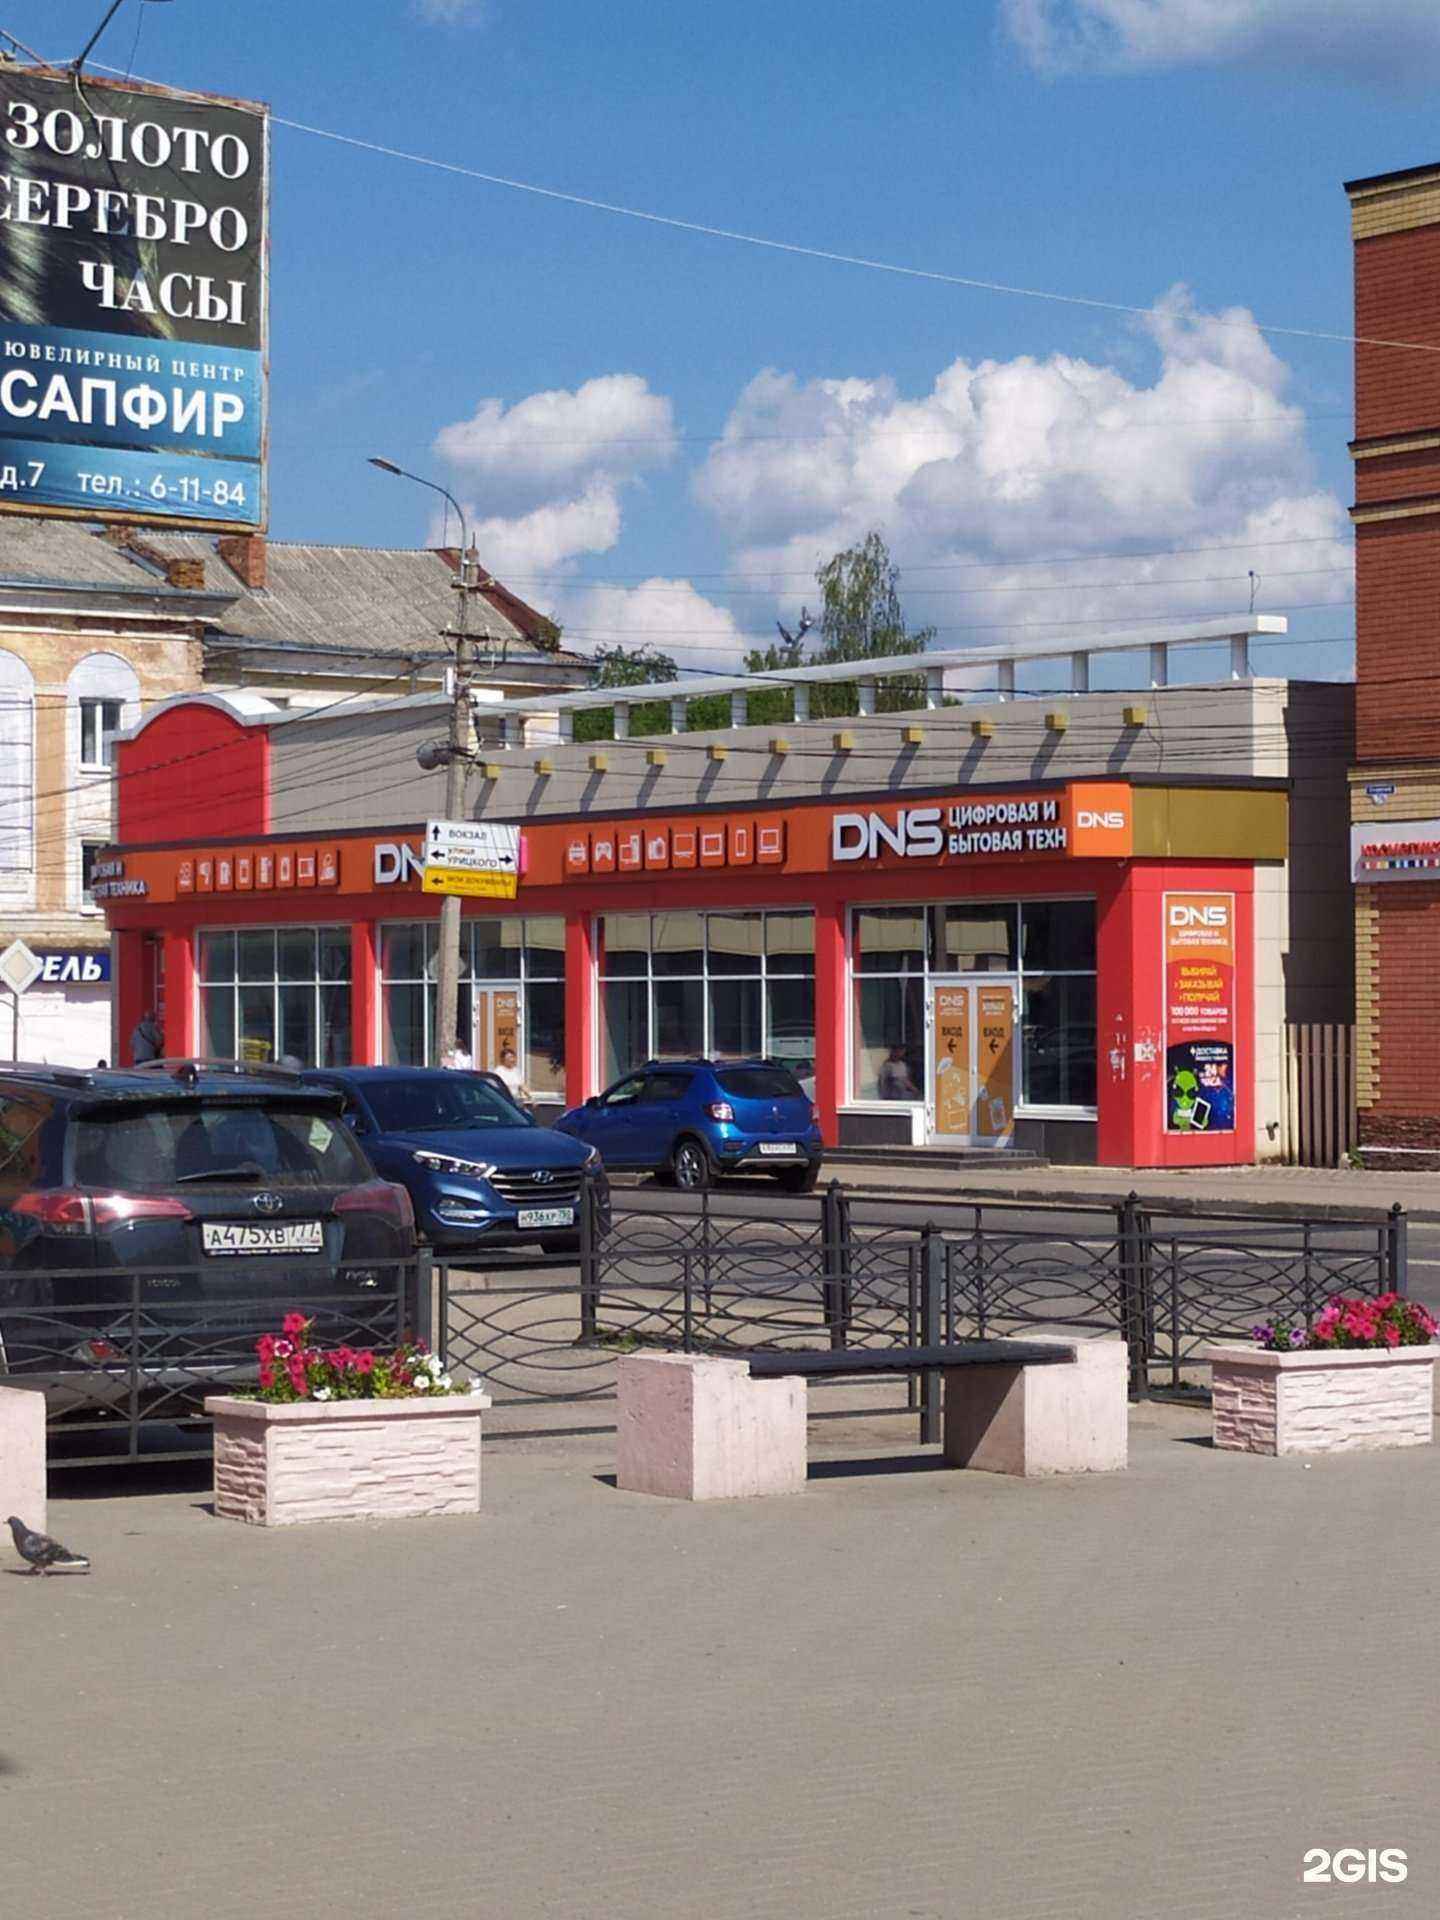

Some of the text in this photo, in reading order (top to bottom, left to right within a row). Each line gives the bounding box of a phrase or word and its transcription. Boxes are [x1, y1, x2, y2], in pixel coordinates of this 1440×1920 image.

[6, 101, 250, 180] ЗОЛОТО
[78, 260, 247, 326] ЧАСЫ
[4, 339, 246, 383] ЮВЕЛИРНЫЙ ЦЕНТР
[1, 368, 245, 438] САПФИР
[149, 474, 246, 507] 6-11-84
[948, 800, 1056, 829] ЦИФРОВАЯ И
[1076, 811, 1125, 829] DNS
[832, 808, 943, 861] DNS
[948, 827, 1067, 855] БЫТОВАЯ ТЕХН
[374, 842, 426, 885] DN
[1169, 905, 1228, 927] DNS
[38, 956, 102, 981] ЕЛЬ
